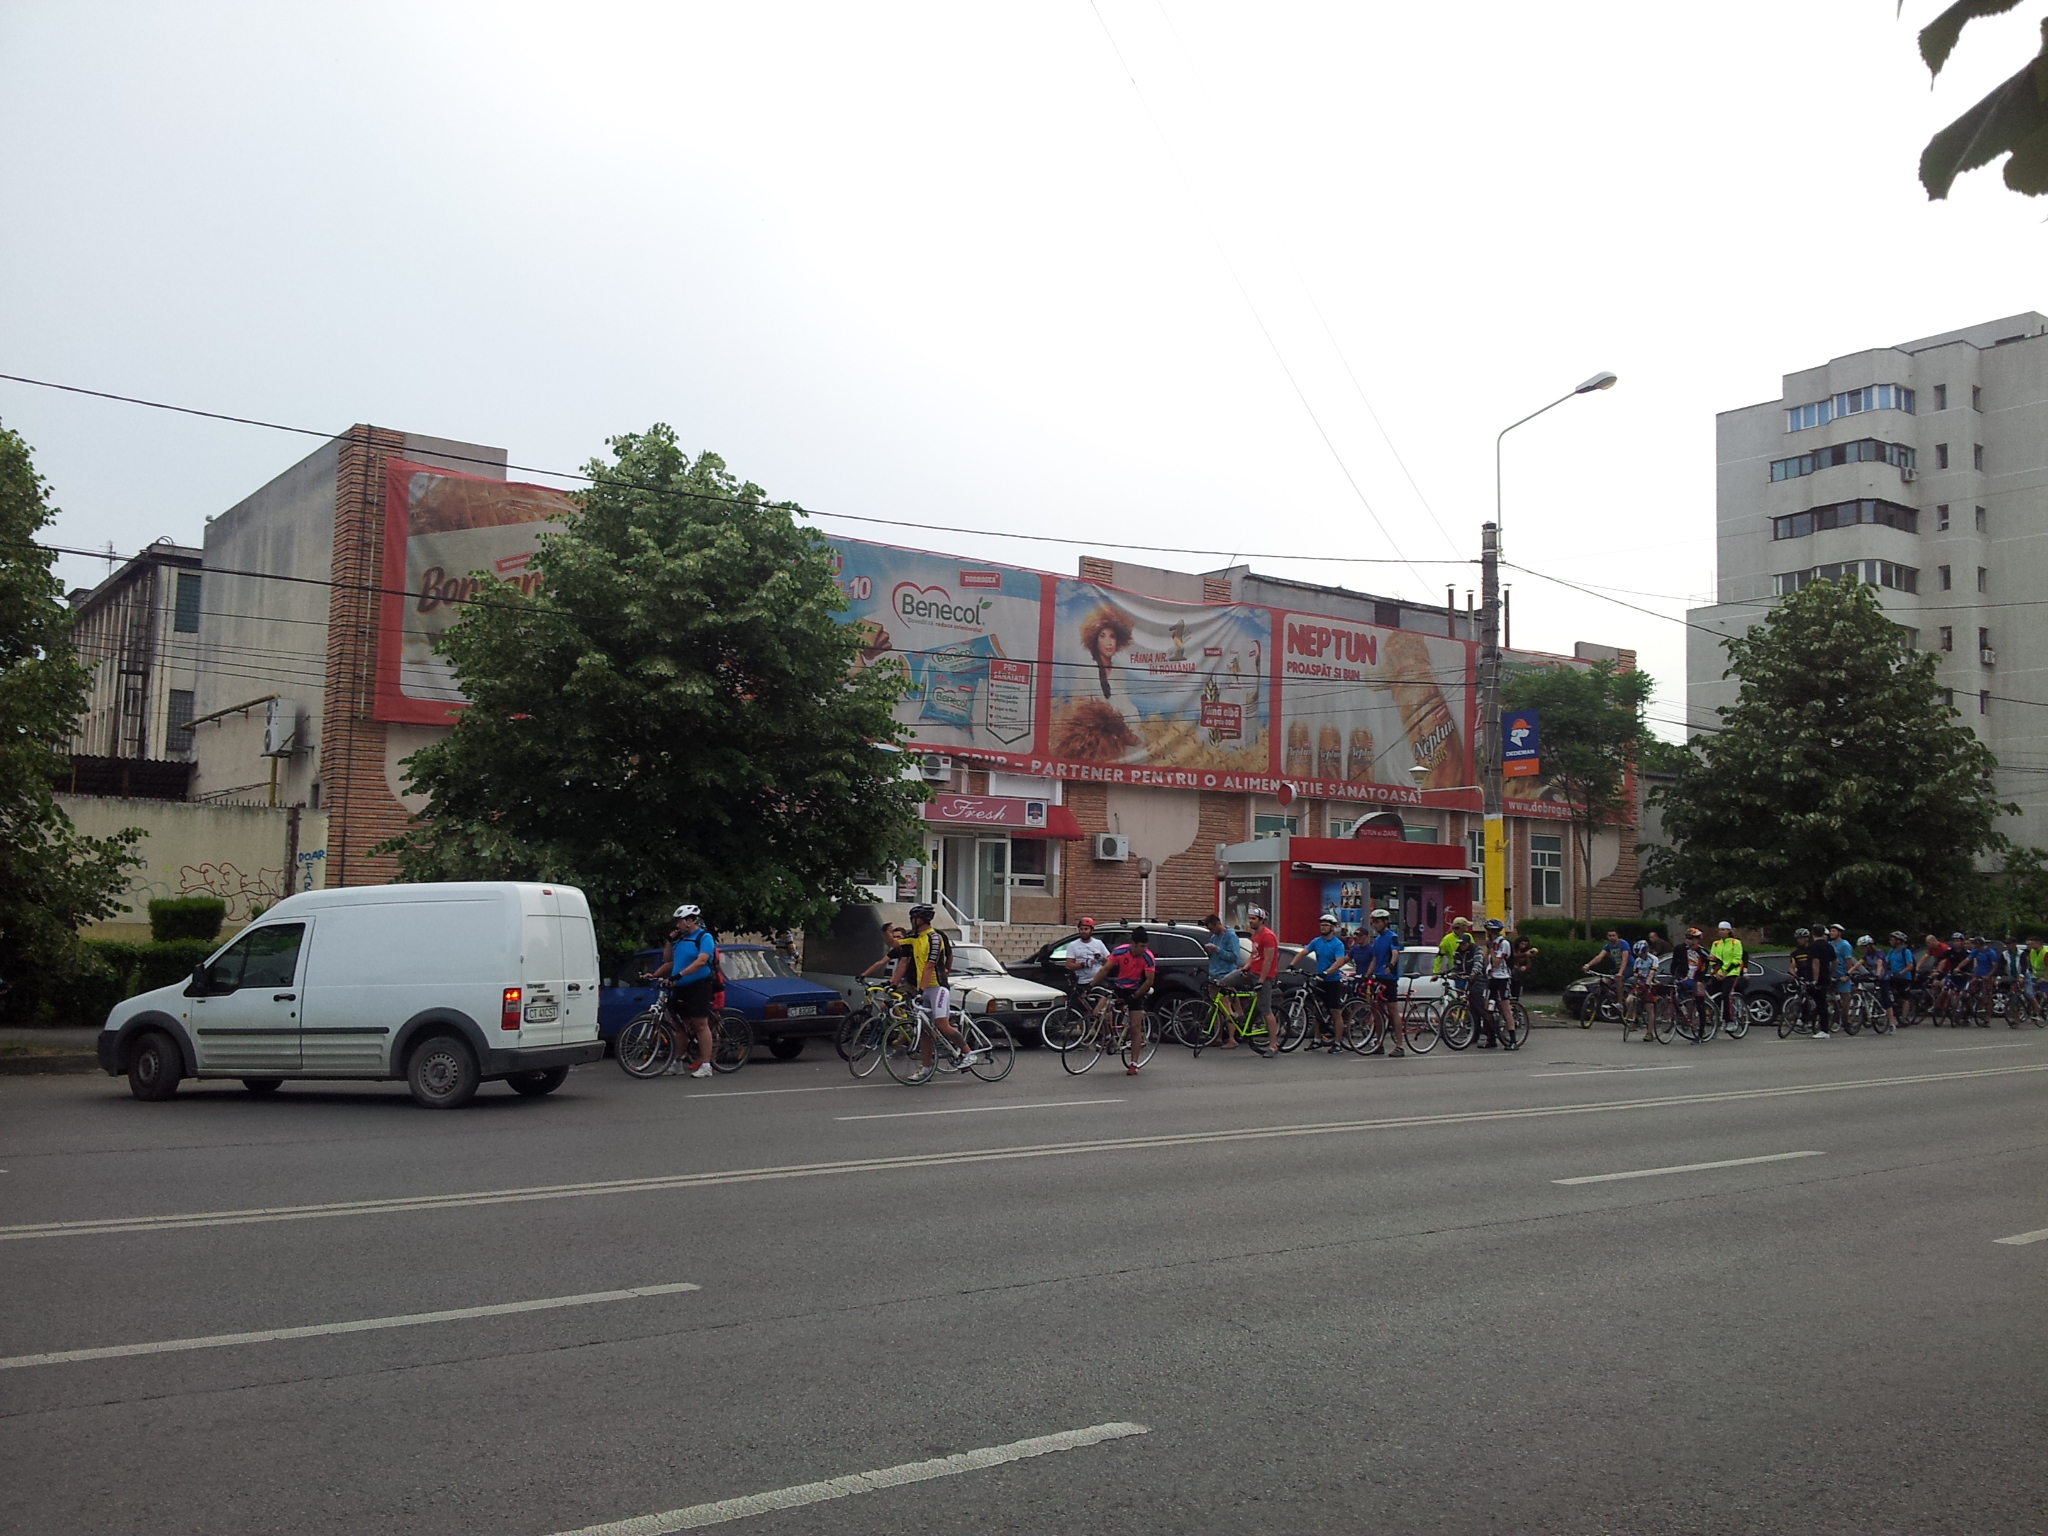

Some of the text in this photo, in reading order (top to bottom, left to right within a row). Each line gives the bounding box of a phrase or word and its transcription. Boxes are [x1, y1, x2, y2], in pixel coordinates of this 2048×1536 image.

[850, 576, 872, 600] 10
[902, 593, 981, 626] Benecol
[1287, 622, 1377, 666] NEPTUN
[1003, 663, 1017, 672] PRO
[1154, 652, 1169, 663] NR.
[1286, 661, 1332, 678] PROASPĂT
[1342, 668, 1360, 681] BUN
[1413, 717, 1455, 760] Neptun
[1505, 749, 1535, 757] DEDEMAN
[1030, 760, 1123, 783] PARTENER
[1130, 768, 1198, 786] PENTRU
[1203, 773, 1218, 788] O
[942, 799, 1008, 821] Fresh
[529, 1008, 538, 1018] CT
